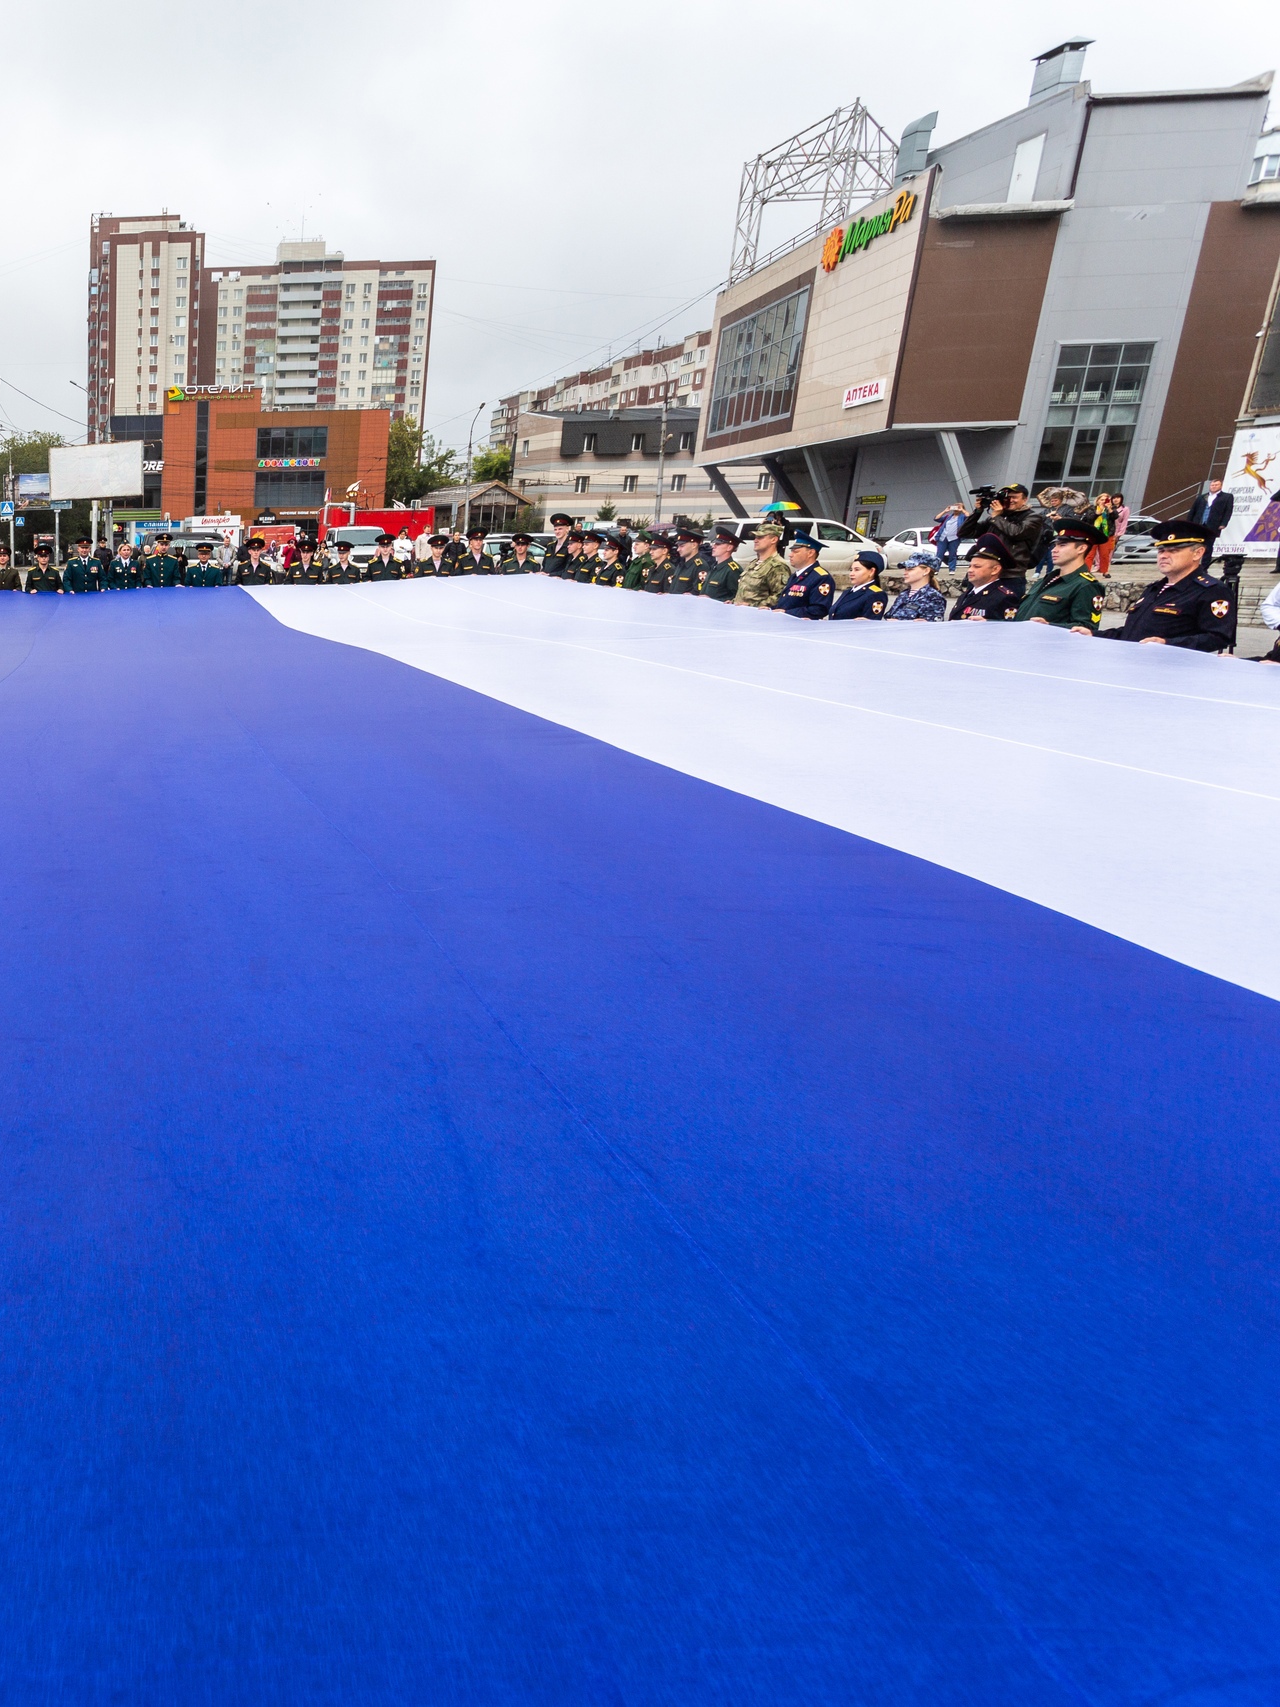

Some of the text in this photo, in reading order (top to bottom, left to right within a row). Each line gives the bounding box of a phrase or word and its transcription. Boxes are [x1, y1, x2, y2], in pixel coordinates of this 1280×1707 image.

[184, 384, 256, 395] ОТЕЛИТ
[845, 382, 879, 402] АПТЕКА
[143, 460, 165, 471] ORE
[1234, 495, 1263, 503] ИОНАЛЬНАЯ
